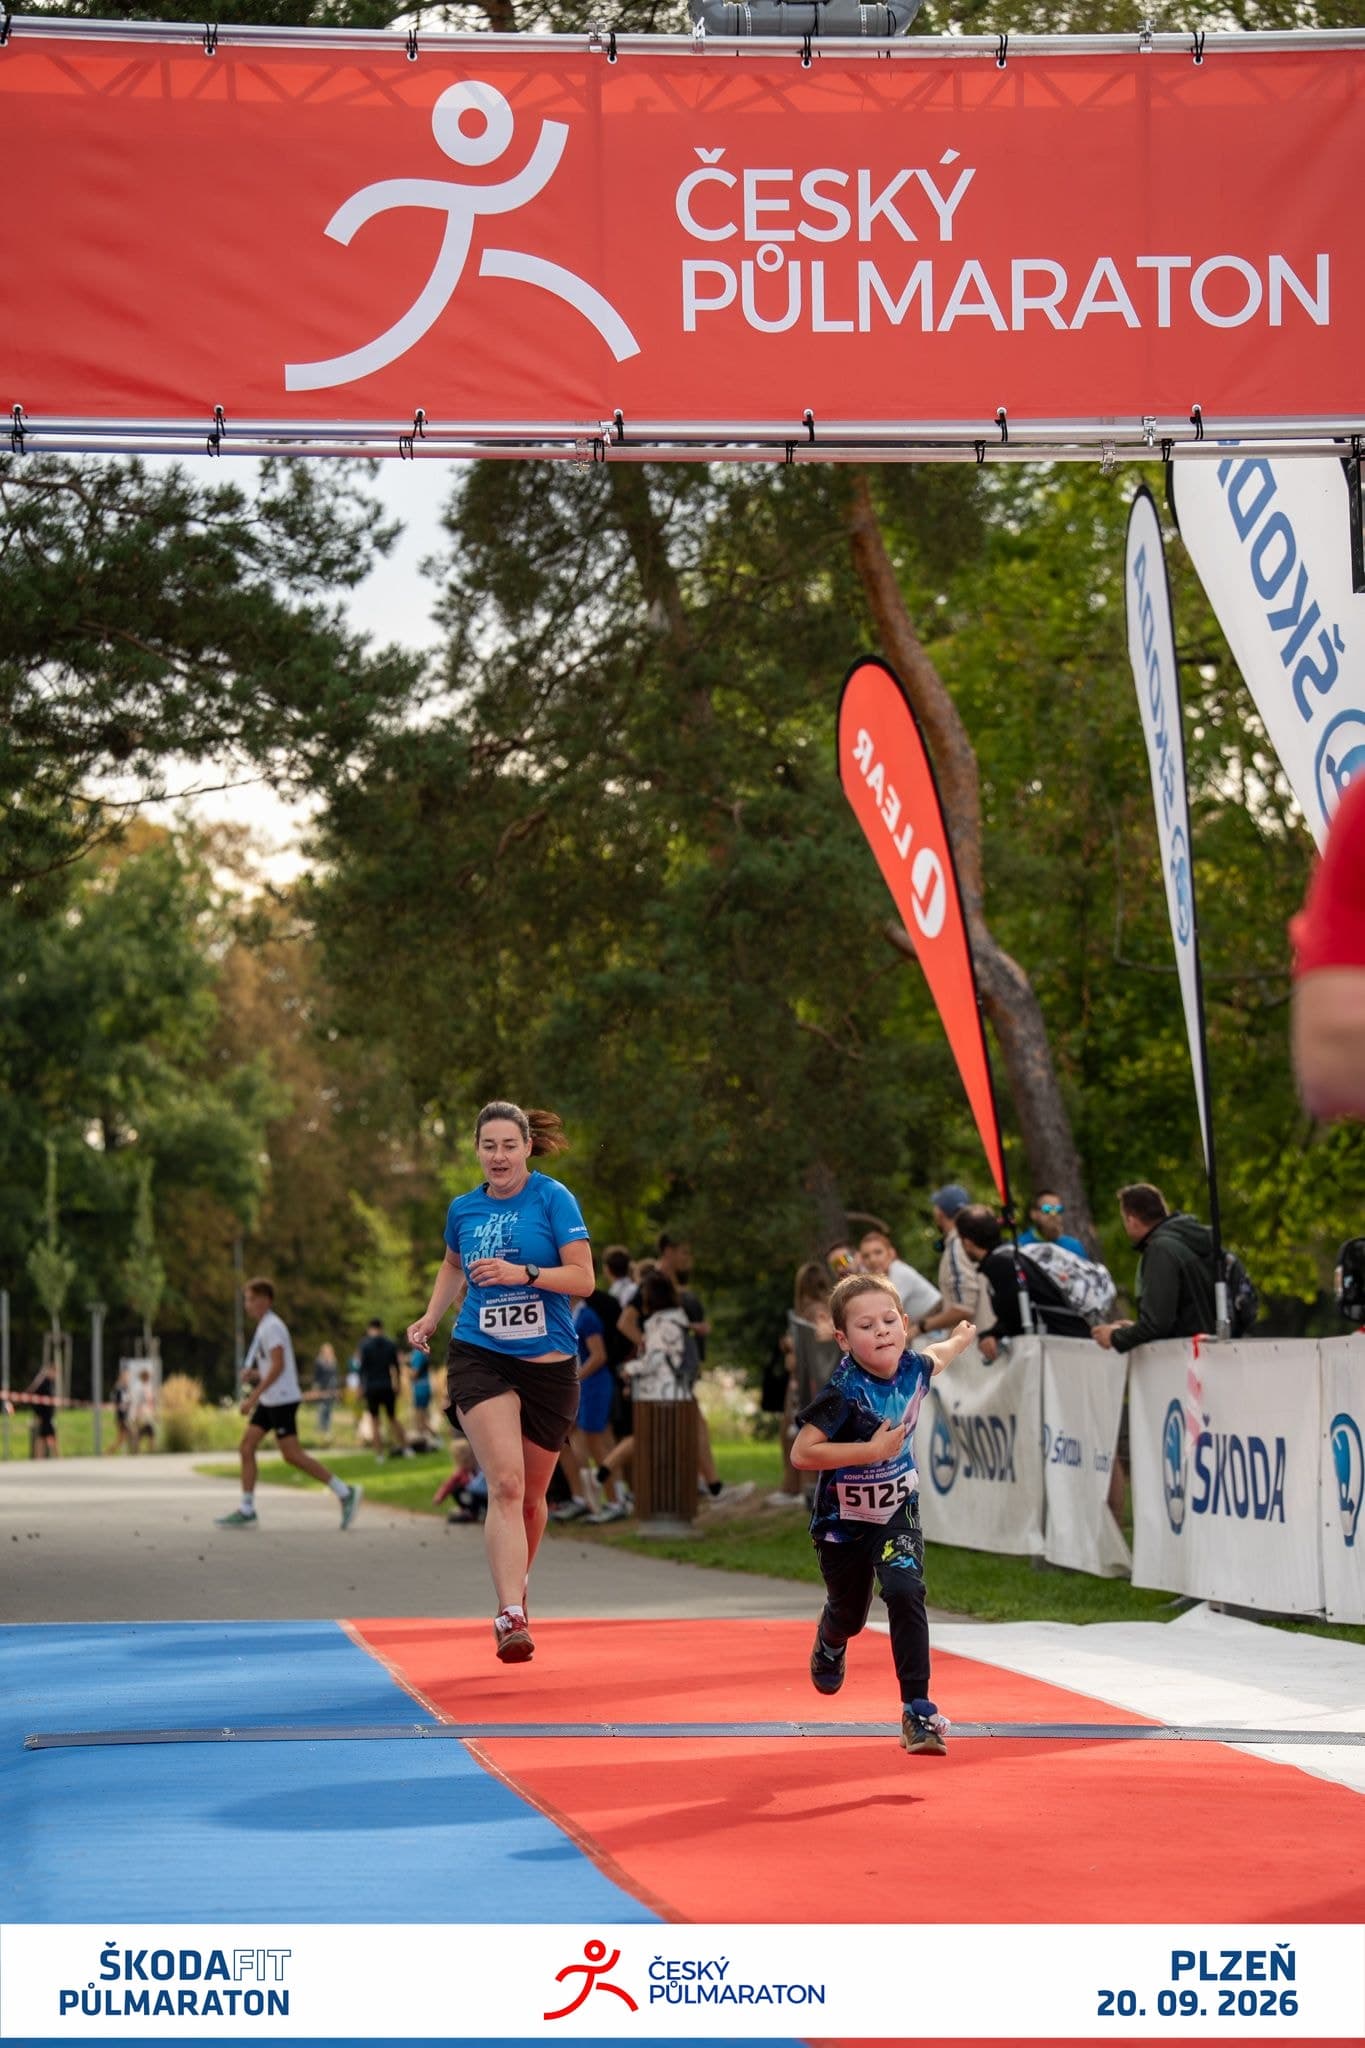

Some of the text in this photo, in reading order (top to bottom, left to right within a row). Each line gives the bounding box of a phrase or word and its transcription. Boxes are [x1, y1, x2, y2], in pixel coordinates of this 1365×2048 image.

[675, 148, 976, 242] ČESKÝ
[682, 243, 1330, 333] PŮLMARATON
[473, 1224, 502, 1238] MA
[484, 1304, 538, 1328] 5126
[845, 1475, 910, 1509] 5125
[1192, 1415, 1286, 1523] ŠKODA
